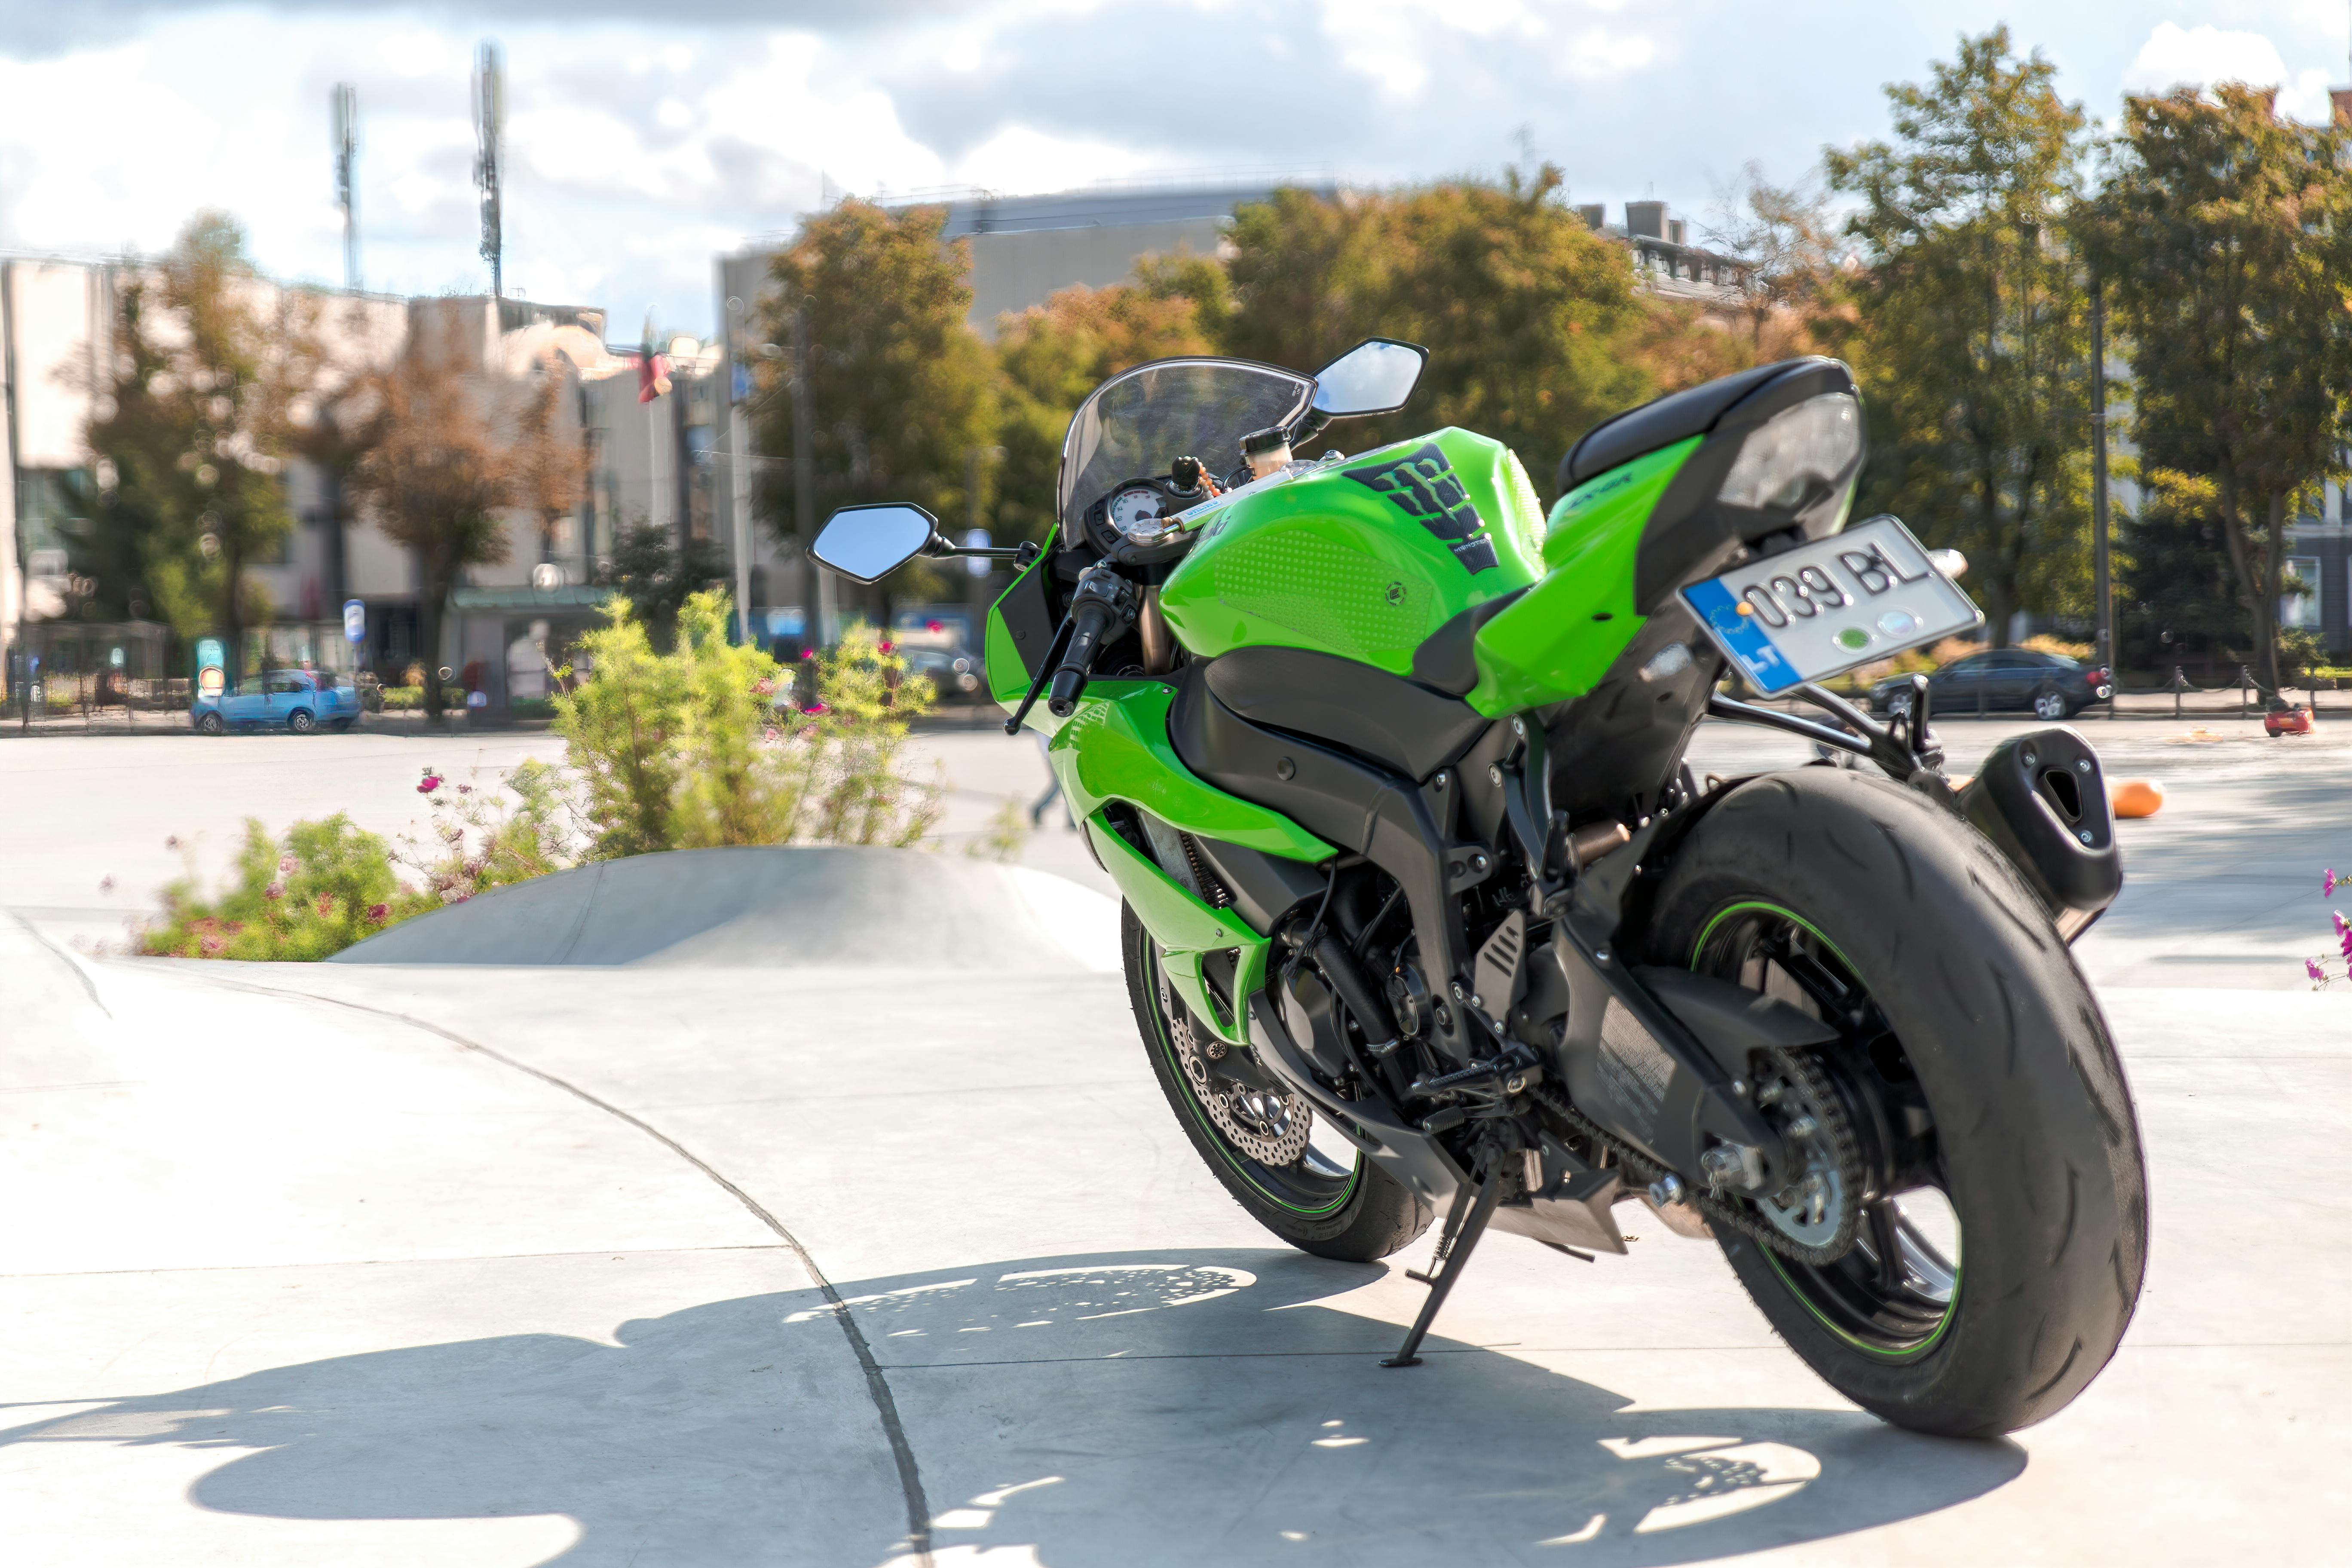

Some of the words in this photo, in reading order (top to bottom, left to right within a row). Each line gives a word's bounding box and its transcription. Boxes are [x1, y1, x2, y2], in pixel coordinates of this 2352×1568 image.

[1742, 563, 1852, 628] 039
[1837, 540, 1933, 596] BL
[1741, 645, 1780, 674] LT
